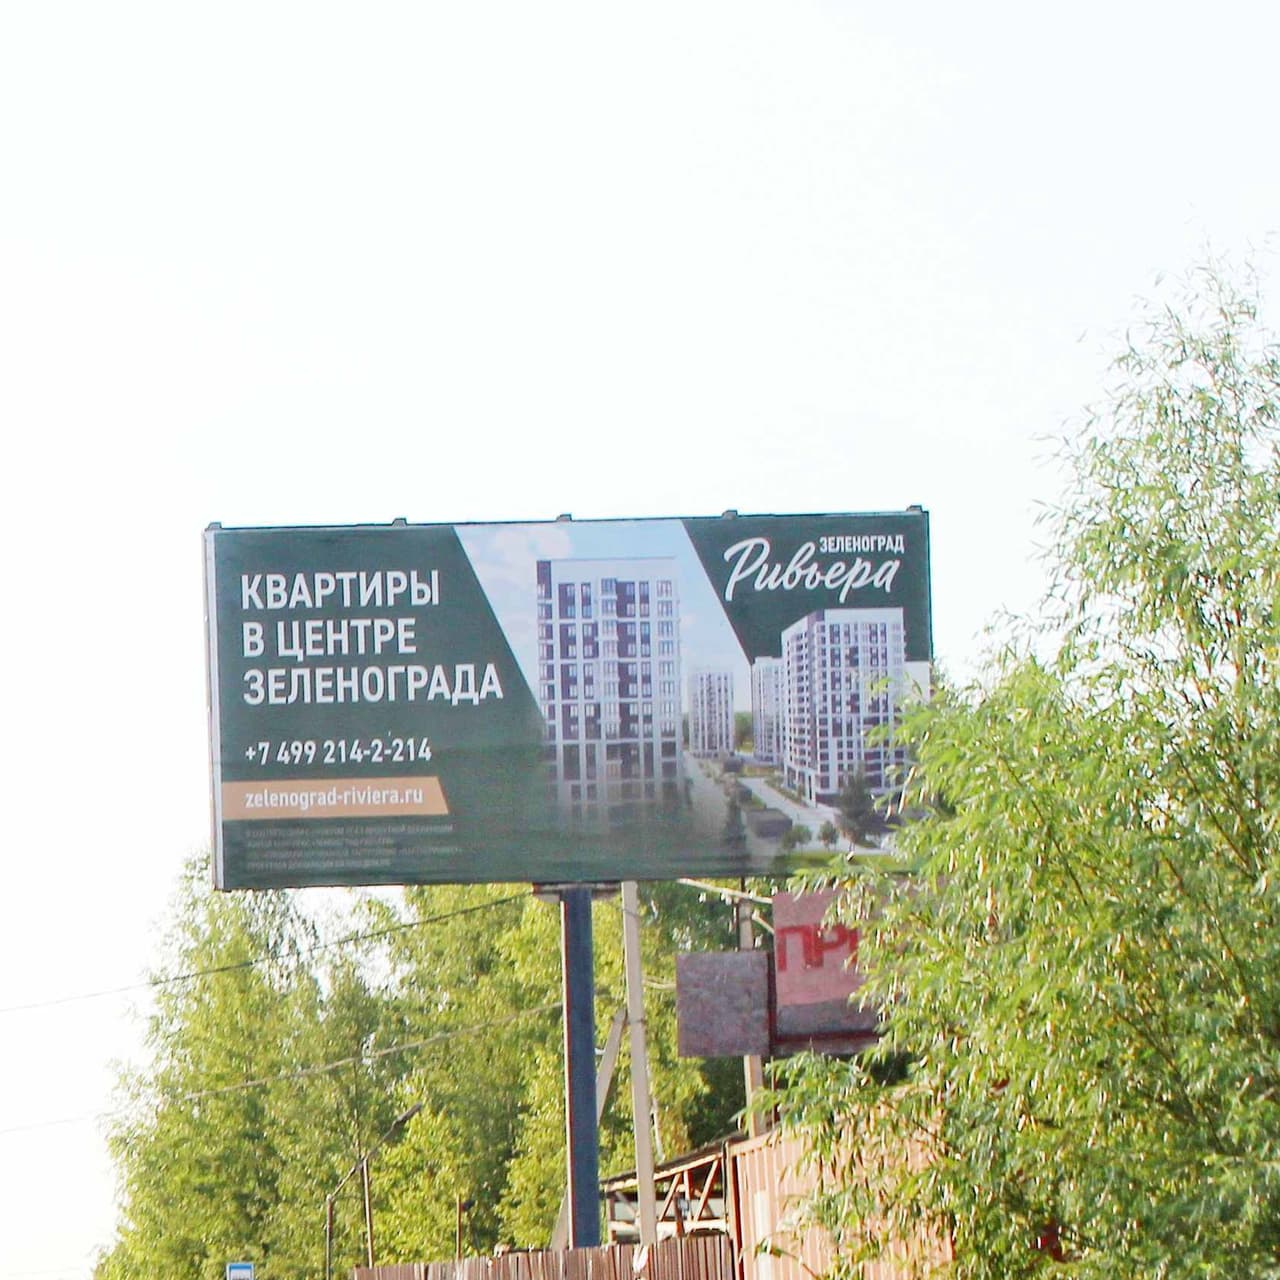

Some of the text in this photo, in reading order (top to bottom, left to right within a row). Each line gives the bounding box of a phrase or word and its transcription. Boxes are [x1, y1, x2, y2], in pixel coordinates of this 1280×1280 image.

[819, 534, 905, 554] ЗЕЛЕНОГРАД
[241, 569, 440, 610] КВАРТИРЫ
[723, 537, 901, 604] Ривьера
[242, 617, 417, 662] В ЦЕНТРЕ
[242, 662, 504, 706] ЗЕЛЕНОГРАДА
[245, 737, 433, 765] +7 499 214-2-214
[245, 786, 424, 811] zelenograd-riviera.ru
